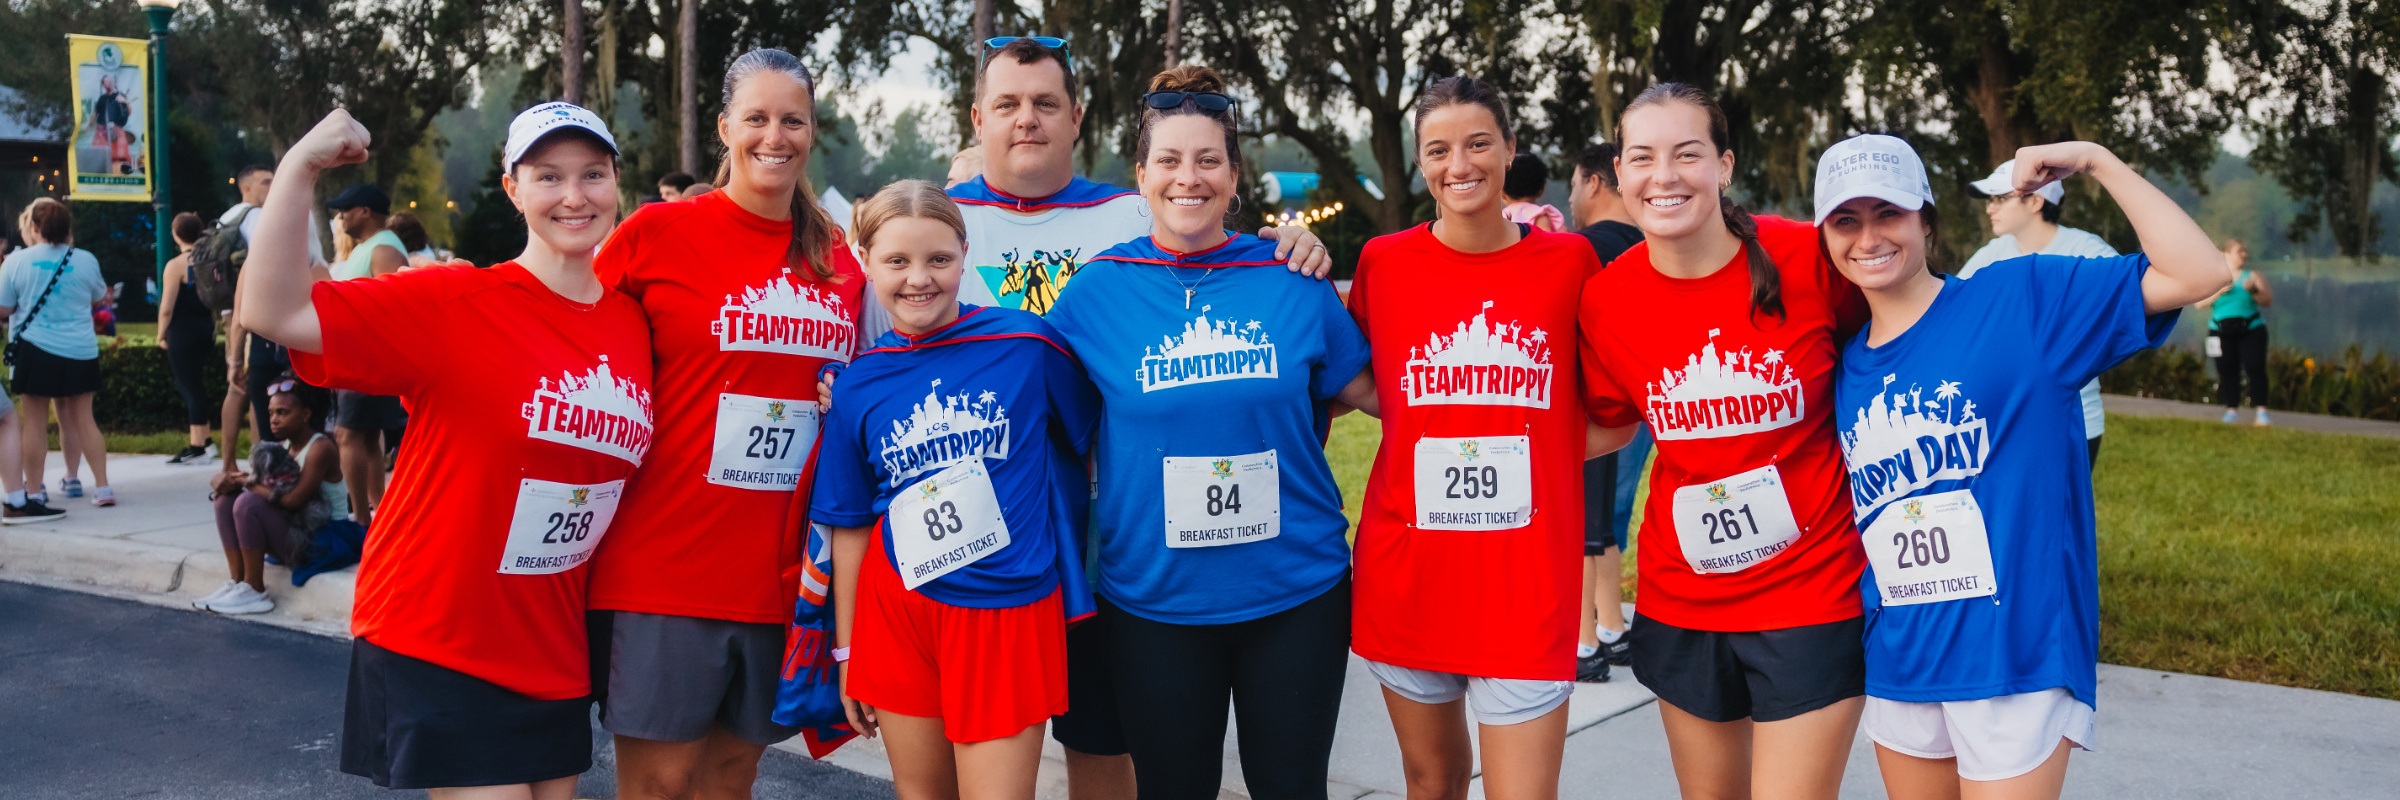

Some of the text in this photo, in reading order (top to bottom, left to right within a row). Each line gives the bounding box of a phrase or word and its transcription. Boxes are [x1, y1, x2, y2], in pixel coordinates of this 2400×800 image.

[1828, 152, 1900, 176] ALTER EGO
[1838, 163, 1888, 178] RUNNING
[1137, 346, 1273, 387] #TEAMTRIPPY
[1402, 364, 1549, 402] #TEAMTRIPPY
[745, 425, 796, 460] 257
[926, 422, 950, 437] LCS
[722, 468, 775, 485] BREAKFAST
[1445, 465, 1498, 499] 259
[1851, 426, 1982, 518] RIPPY DAY
[1206, 483, 1242, 516] 84
[542, 510, 595, 544] 258
[923, 500, 963, 541] 83
[1180, 522, 1268, 542] BREAKFAST TICKET
[1429, 511, 1518, 525] BREAKFAST TICKET
[1701, 503, 1759, 545] 261
[515, 548, 592, 569] BREAKFAST TICKET
[913, 531, 999, 579] BREAKFAST TICKET
[1700, 539, 1789, 570] BREAKFAST TICKET
[1892, 526, 1951, 570] 260
[1888, 575, 1979, 599] BREAKFAST TICKET
